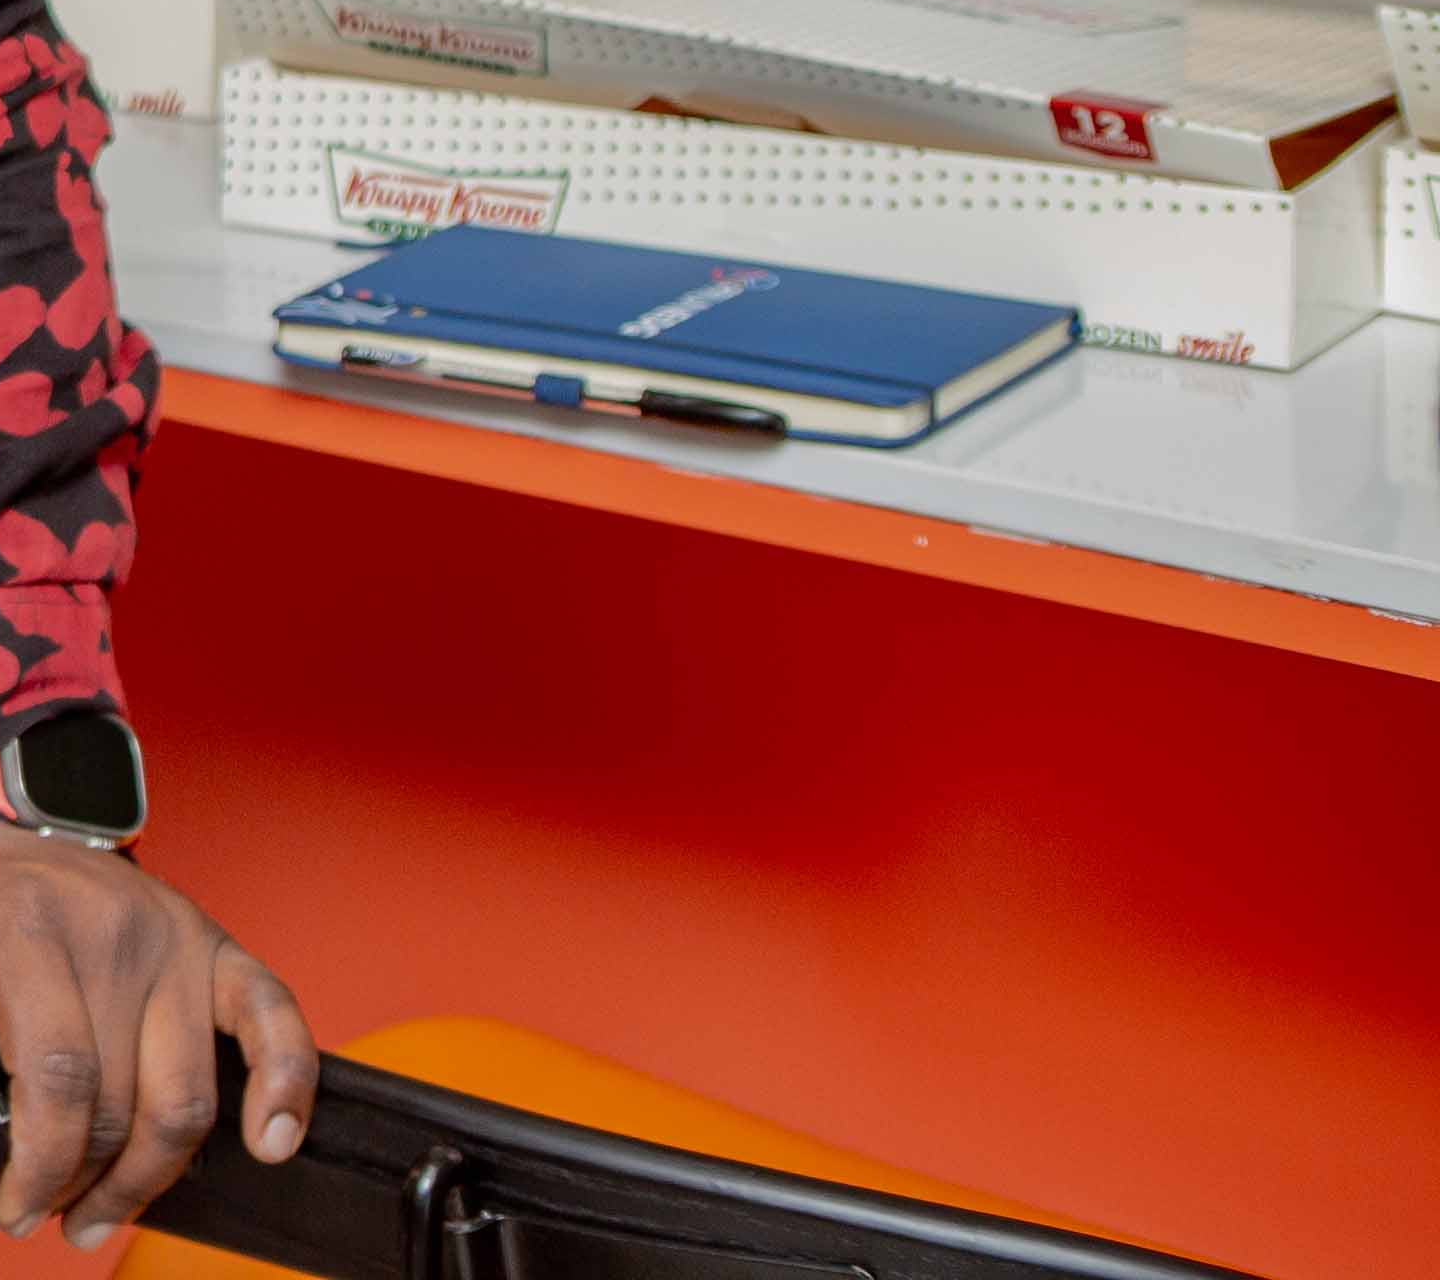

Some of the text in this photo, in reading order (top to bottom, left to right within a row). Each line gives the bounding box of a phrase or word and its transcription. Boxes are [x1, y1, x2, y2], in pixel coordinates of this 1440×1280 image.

[1072, 105, 1131, 144] 12
[343, 164, 551, 227] Krispy Kreme
[1175, 329, 1257, 366] smile
